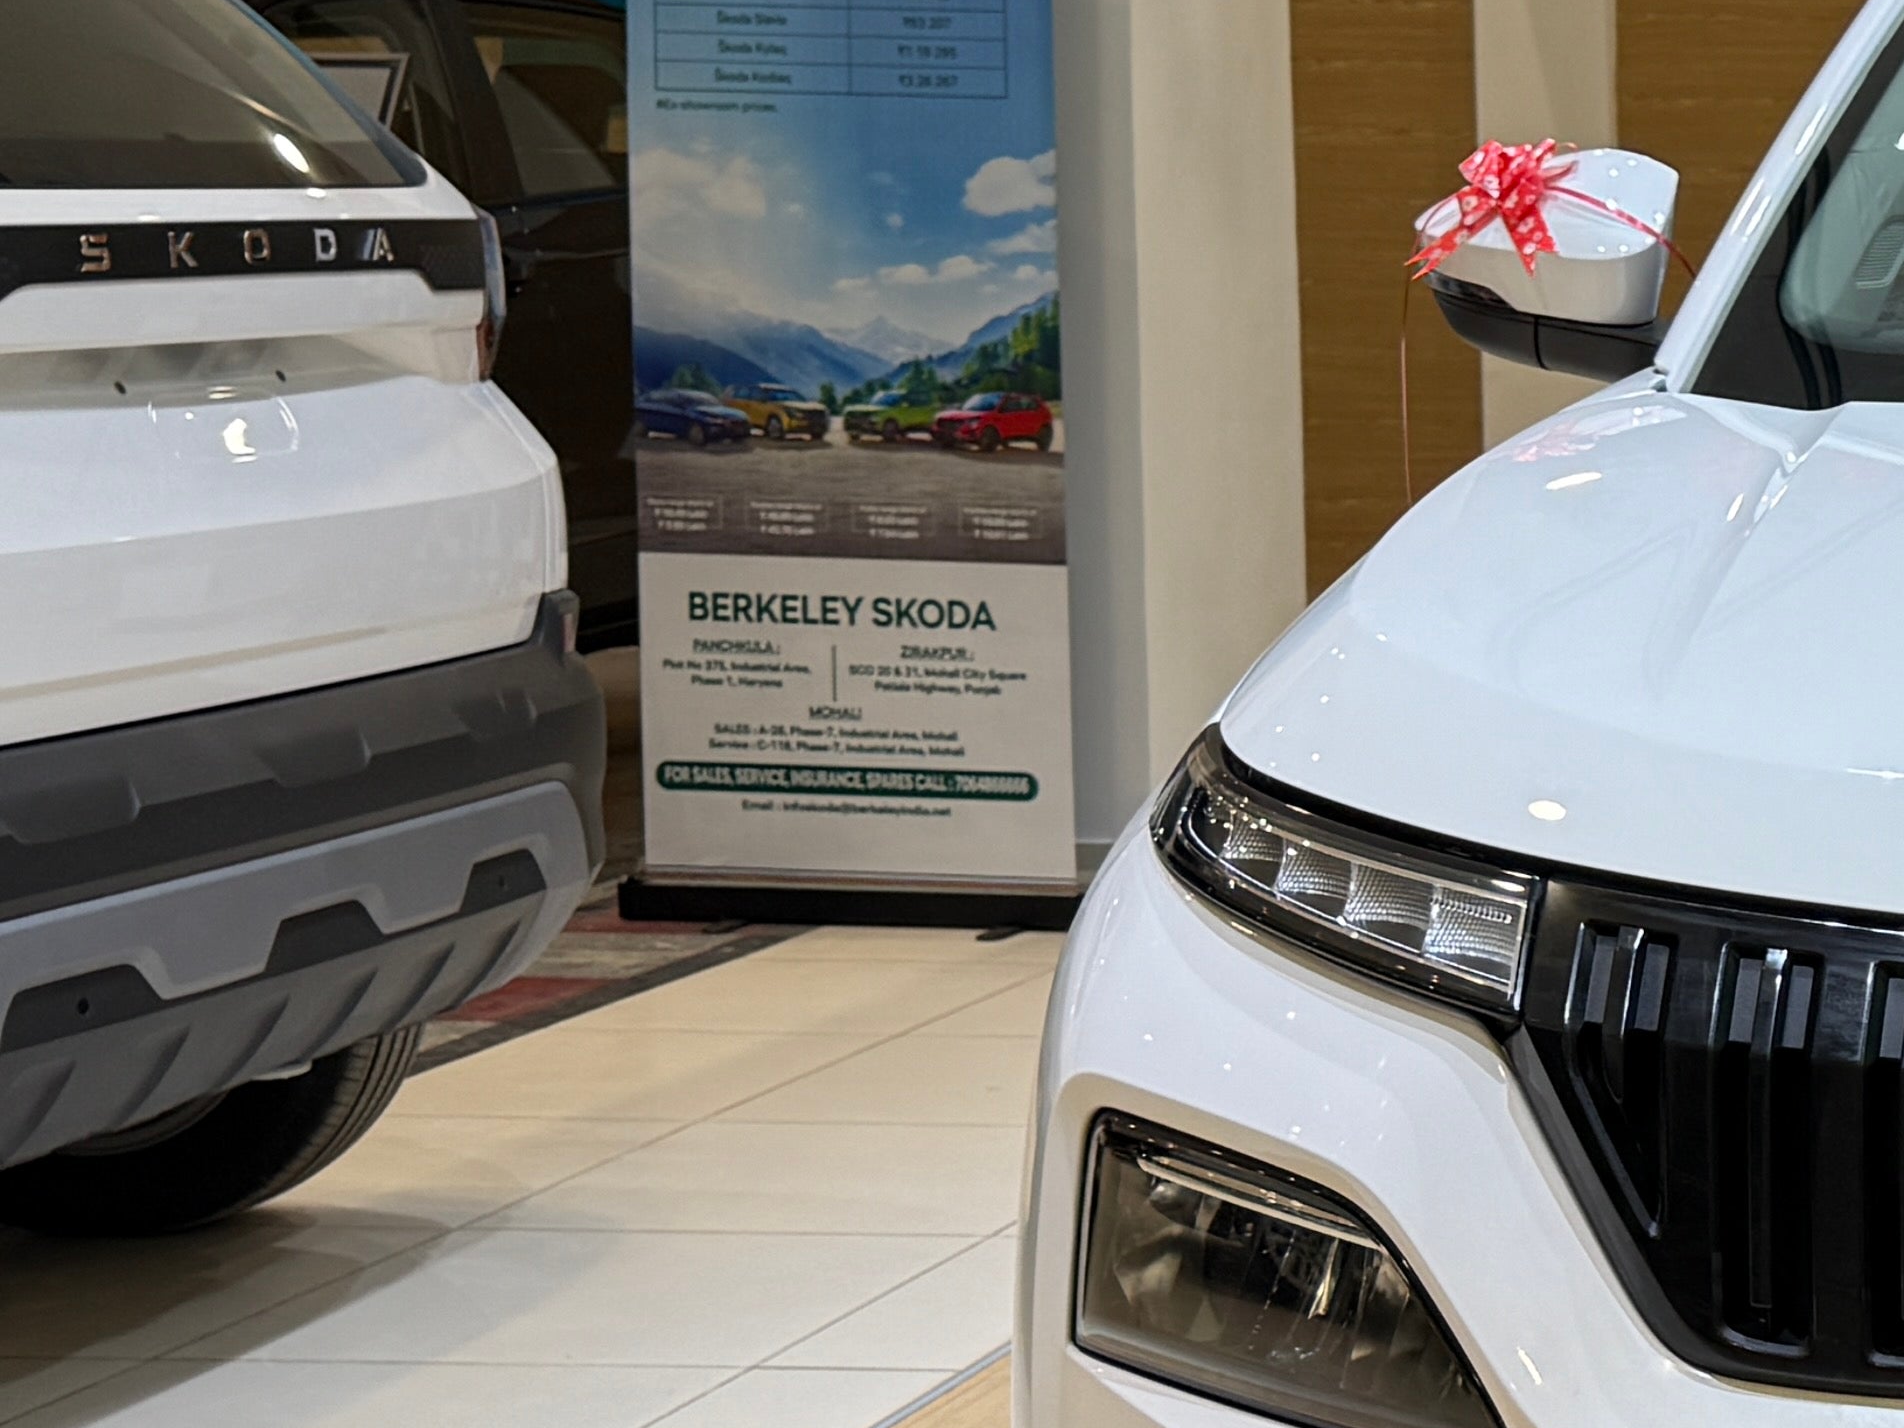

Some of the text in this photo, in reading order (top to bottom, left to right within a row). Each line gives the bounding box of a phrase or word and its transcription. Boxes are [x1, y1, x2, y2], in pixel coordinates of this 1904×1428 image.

[79, 227, 395, 273] SKODA
[688, 591, 997, 632] BERKELEY SKODA
